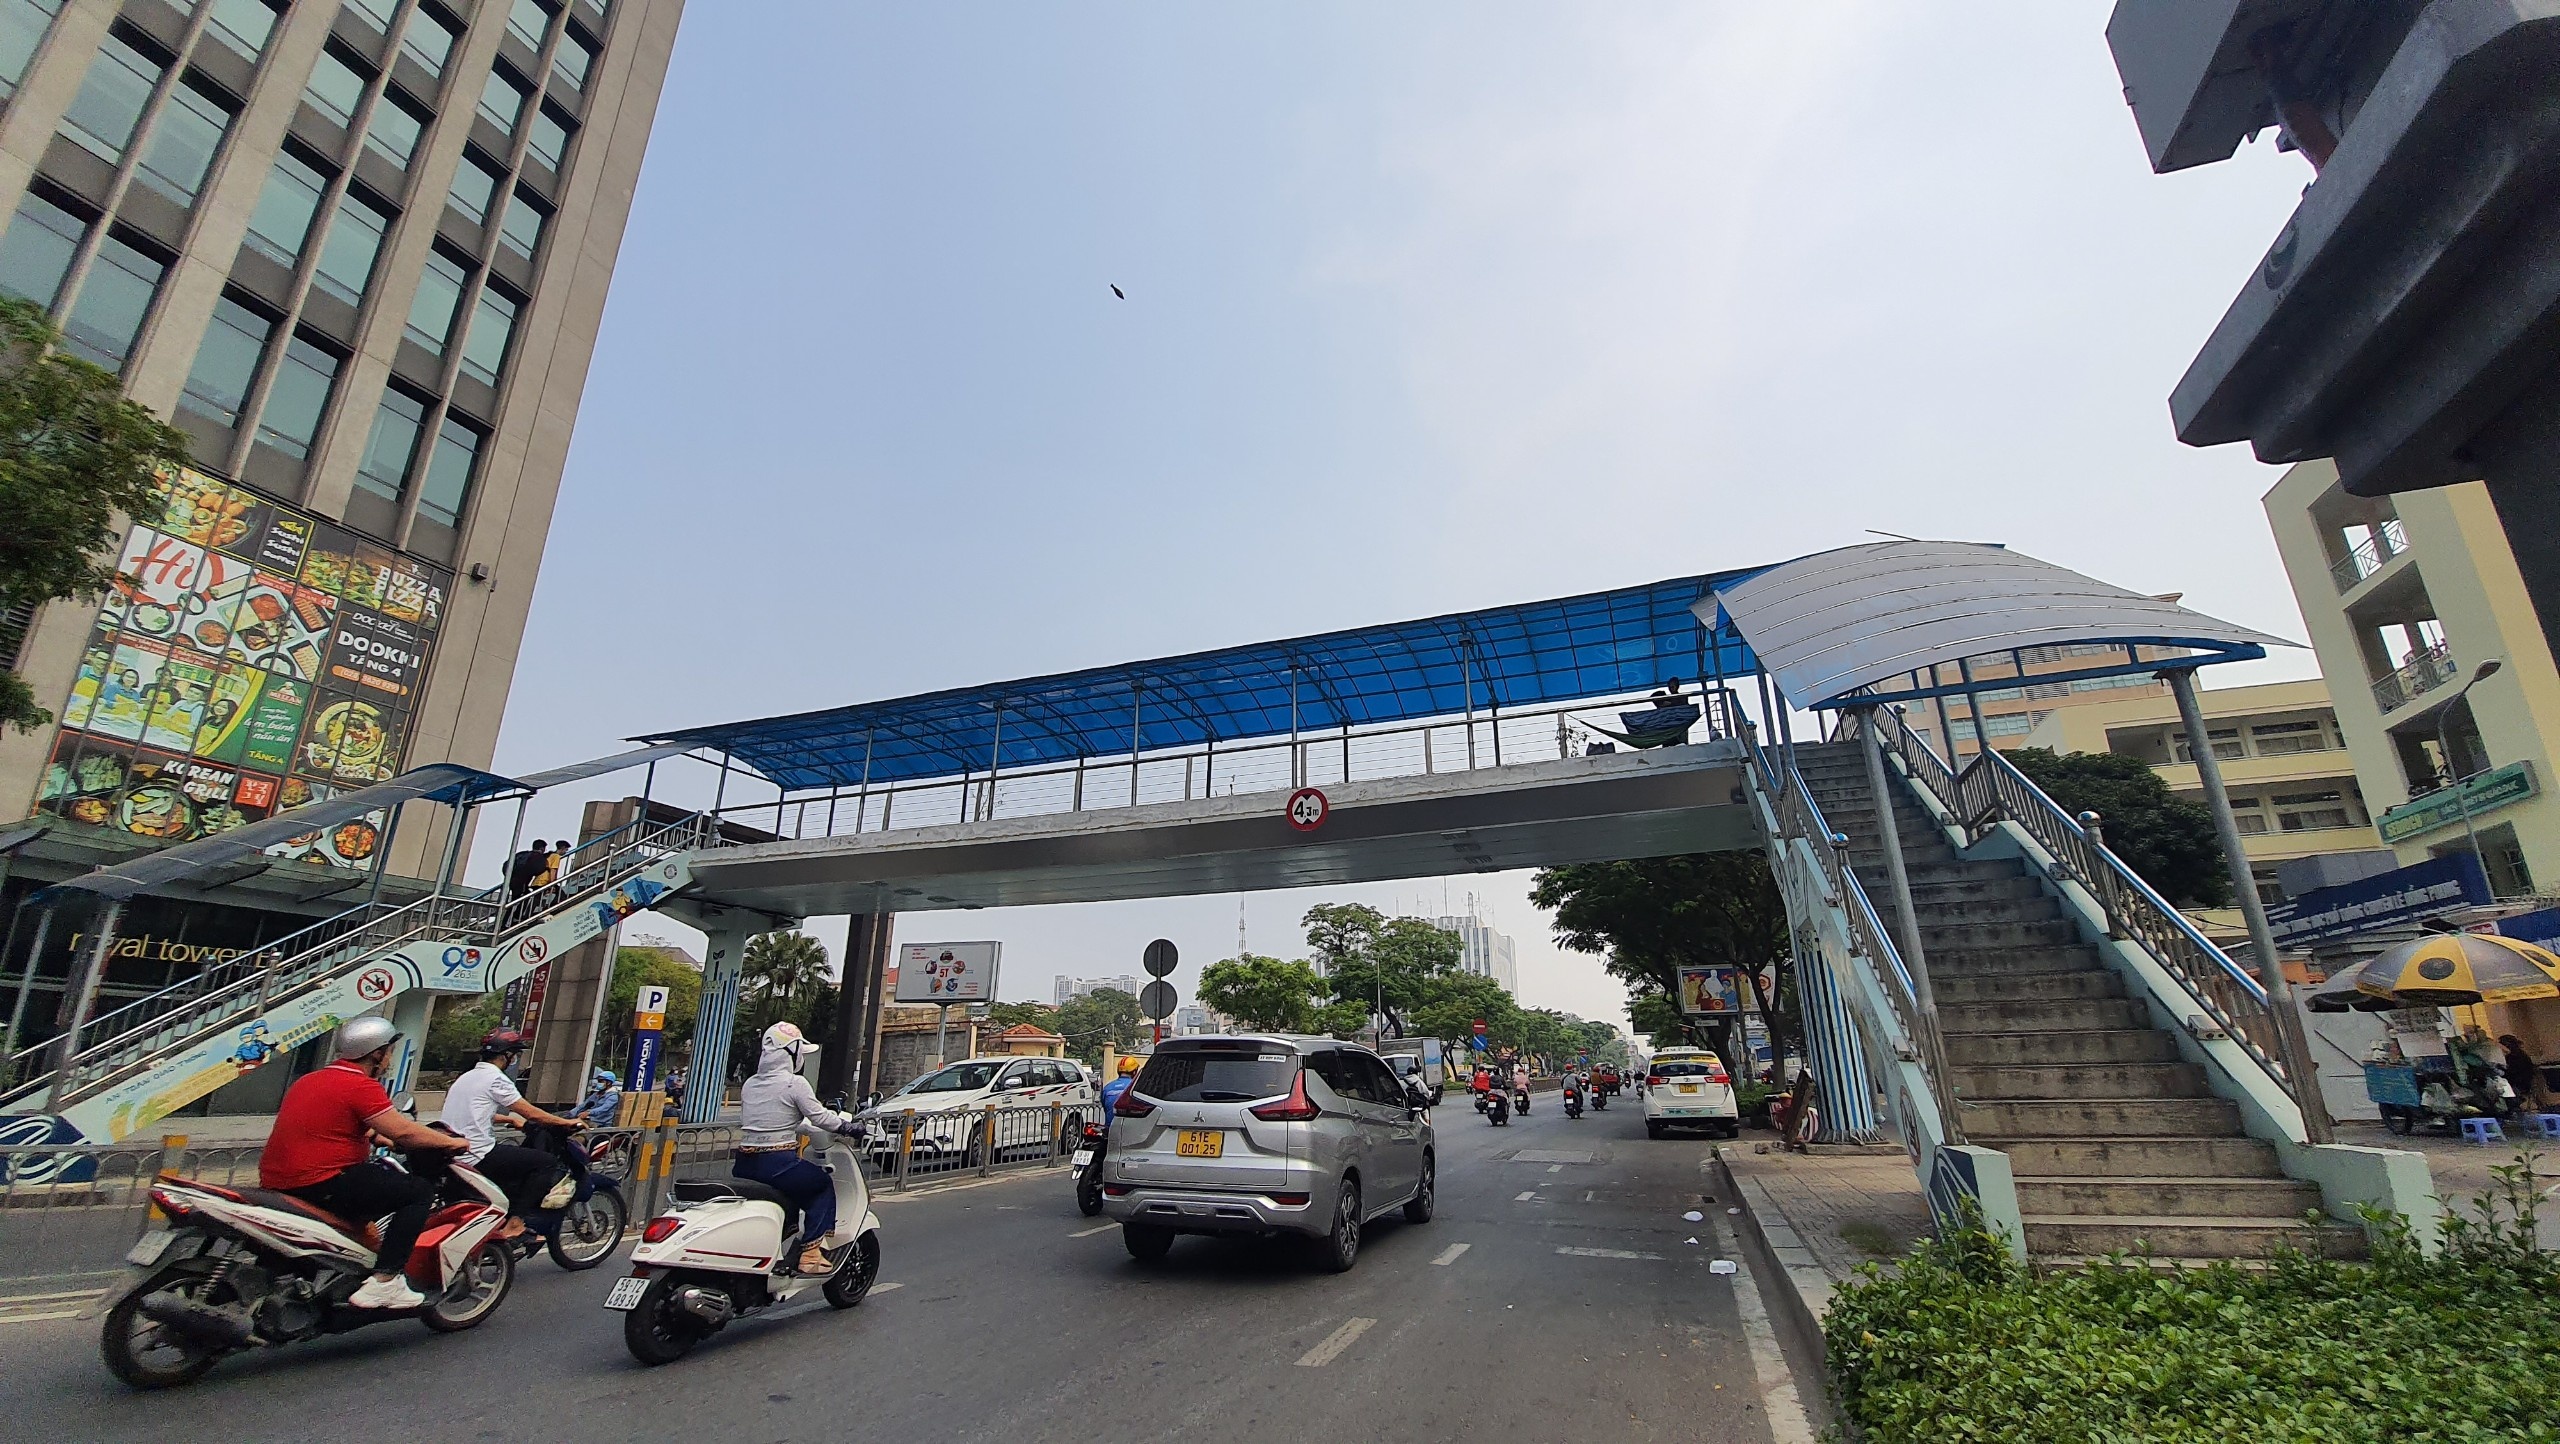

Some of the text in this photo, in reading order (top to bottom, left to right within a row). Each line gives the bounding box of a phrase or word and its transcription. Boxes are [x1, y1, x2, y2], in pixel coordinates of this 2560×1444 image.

[337, 630, 420, 669] DOOKKI
[183, 781, 230, 801] GRILL
[69, 932, 151, 957] ryal
[649, 991, 663, 1010] P
[1191, 1131, 1210, 1143] 61E
[1181, 1142, 1216, 1155] 001.25
